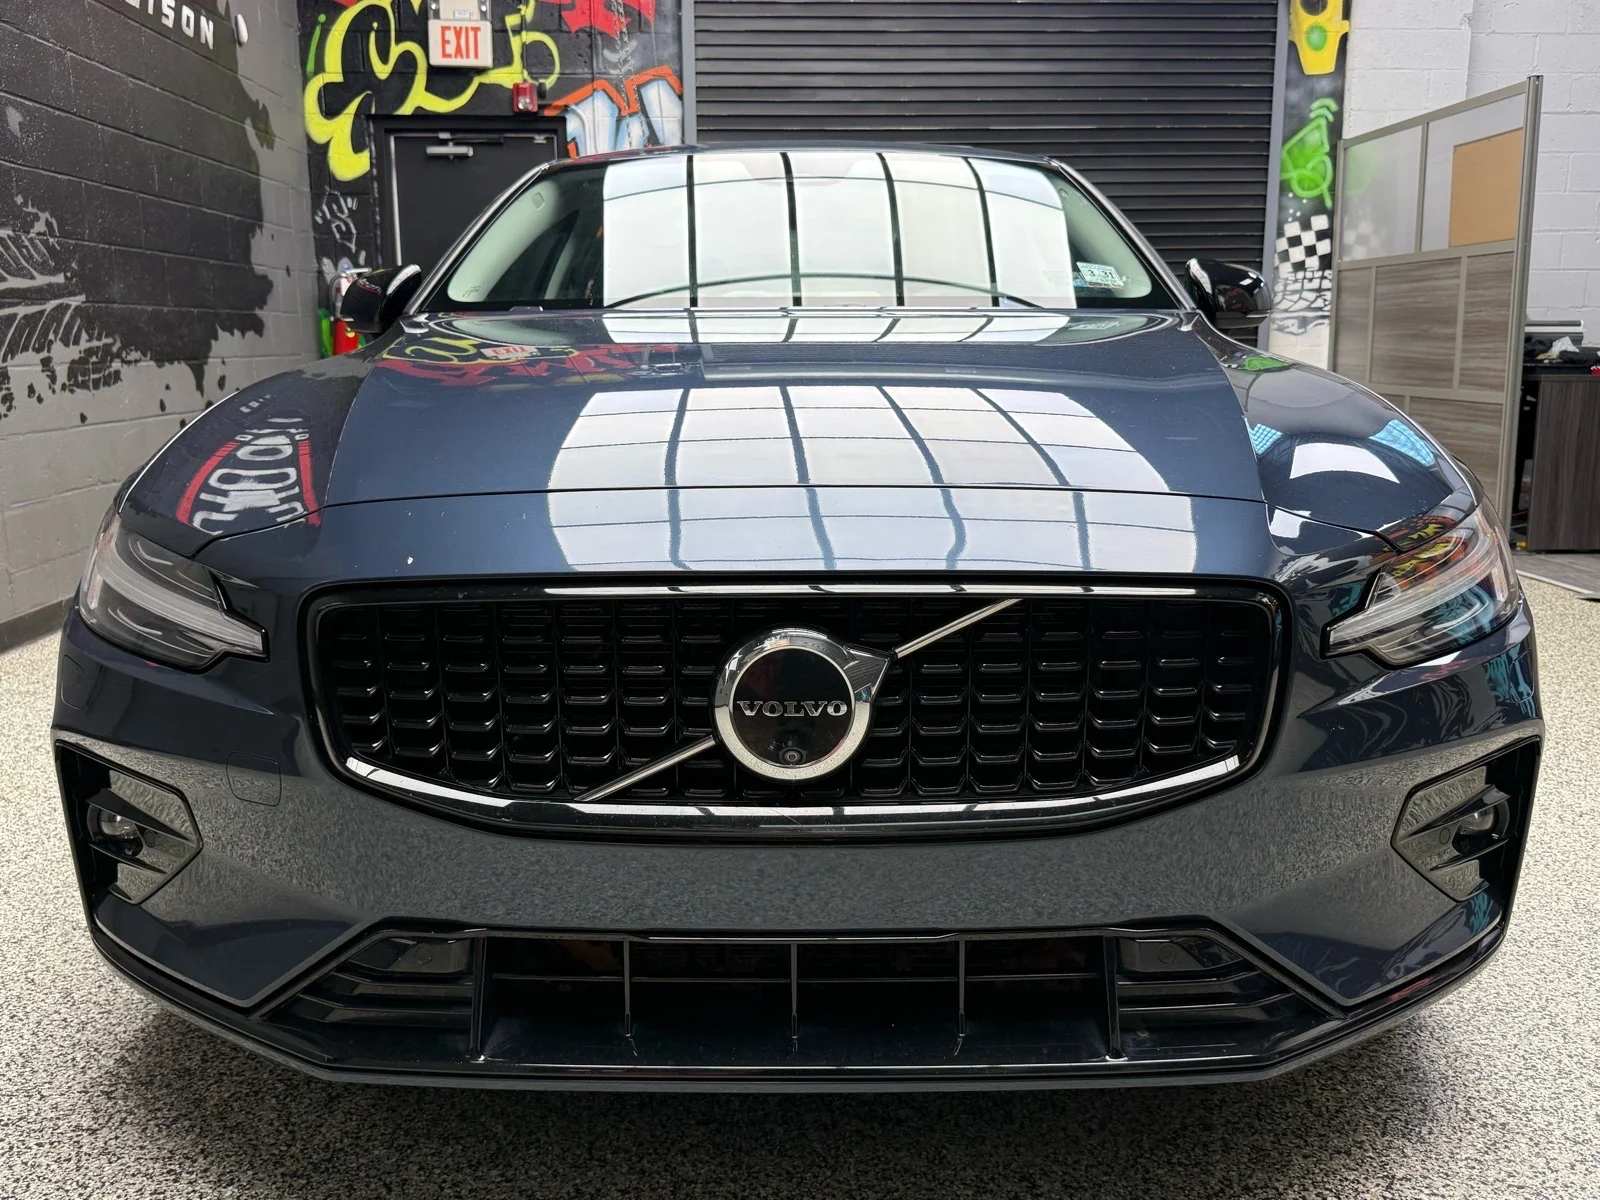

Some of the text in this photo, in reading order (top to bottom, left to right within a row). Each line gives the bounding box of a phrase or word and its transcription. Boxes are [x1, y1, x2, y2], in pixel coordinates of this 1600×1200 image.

[124, 0, 214, 50] ISON
[441, 25, 481, 60] EXIT
[736, 700, 848, 717] VOLVO
